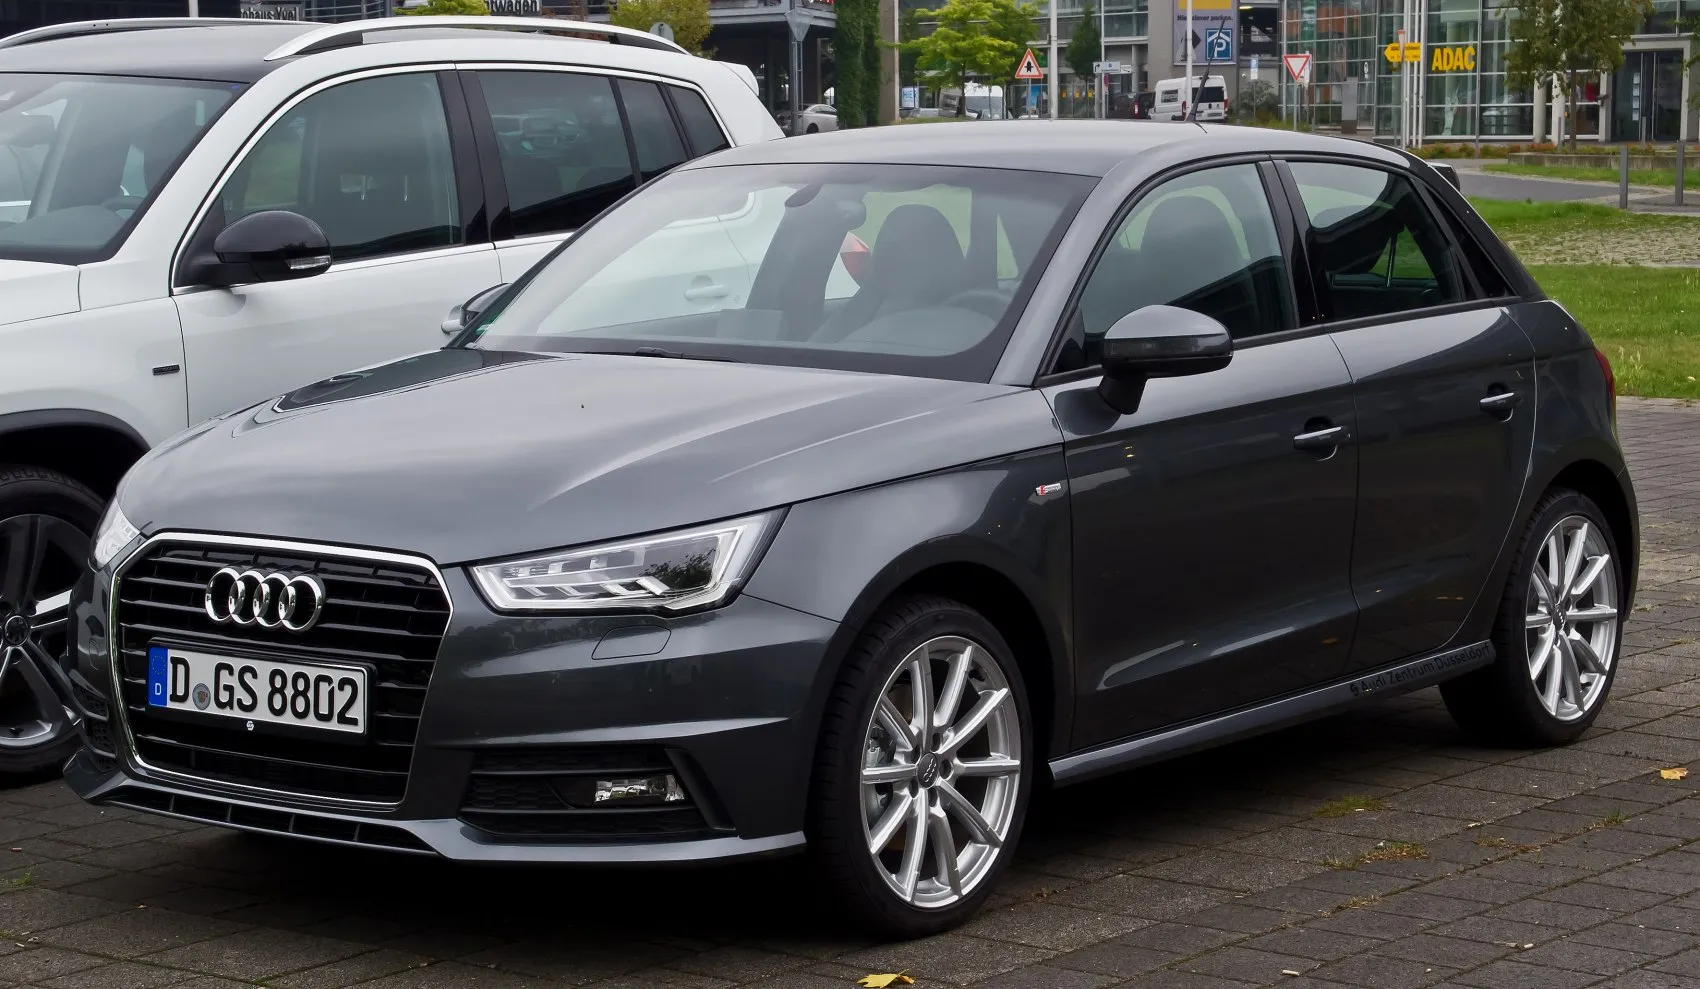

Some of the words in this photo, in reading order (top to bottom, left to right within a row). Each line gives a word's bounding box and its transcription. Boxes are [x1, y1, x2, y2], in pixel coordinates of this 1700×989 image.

[1432, 46, 1475, 71] ADAC
[154, 682, 162, 696] D
[1361, 675, 1388, 691] Audi
[1387, 662, 1436, 685] Zentrum
[169, 656, 190, 703] D
[213, 662, 258, 713] GS
[267, 668, 359, 726] 8802
